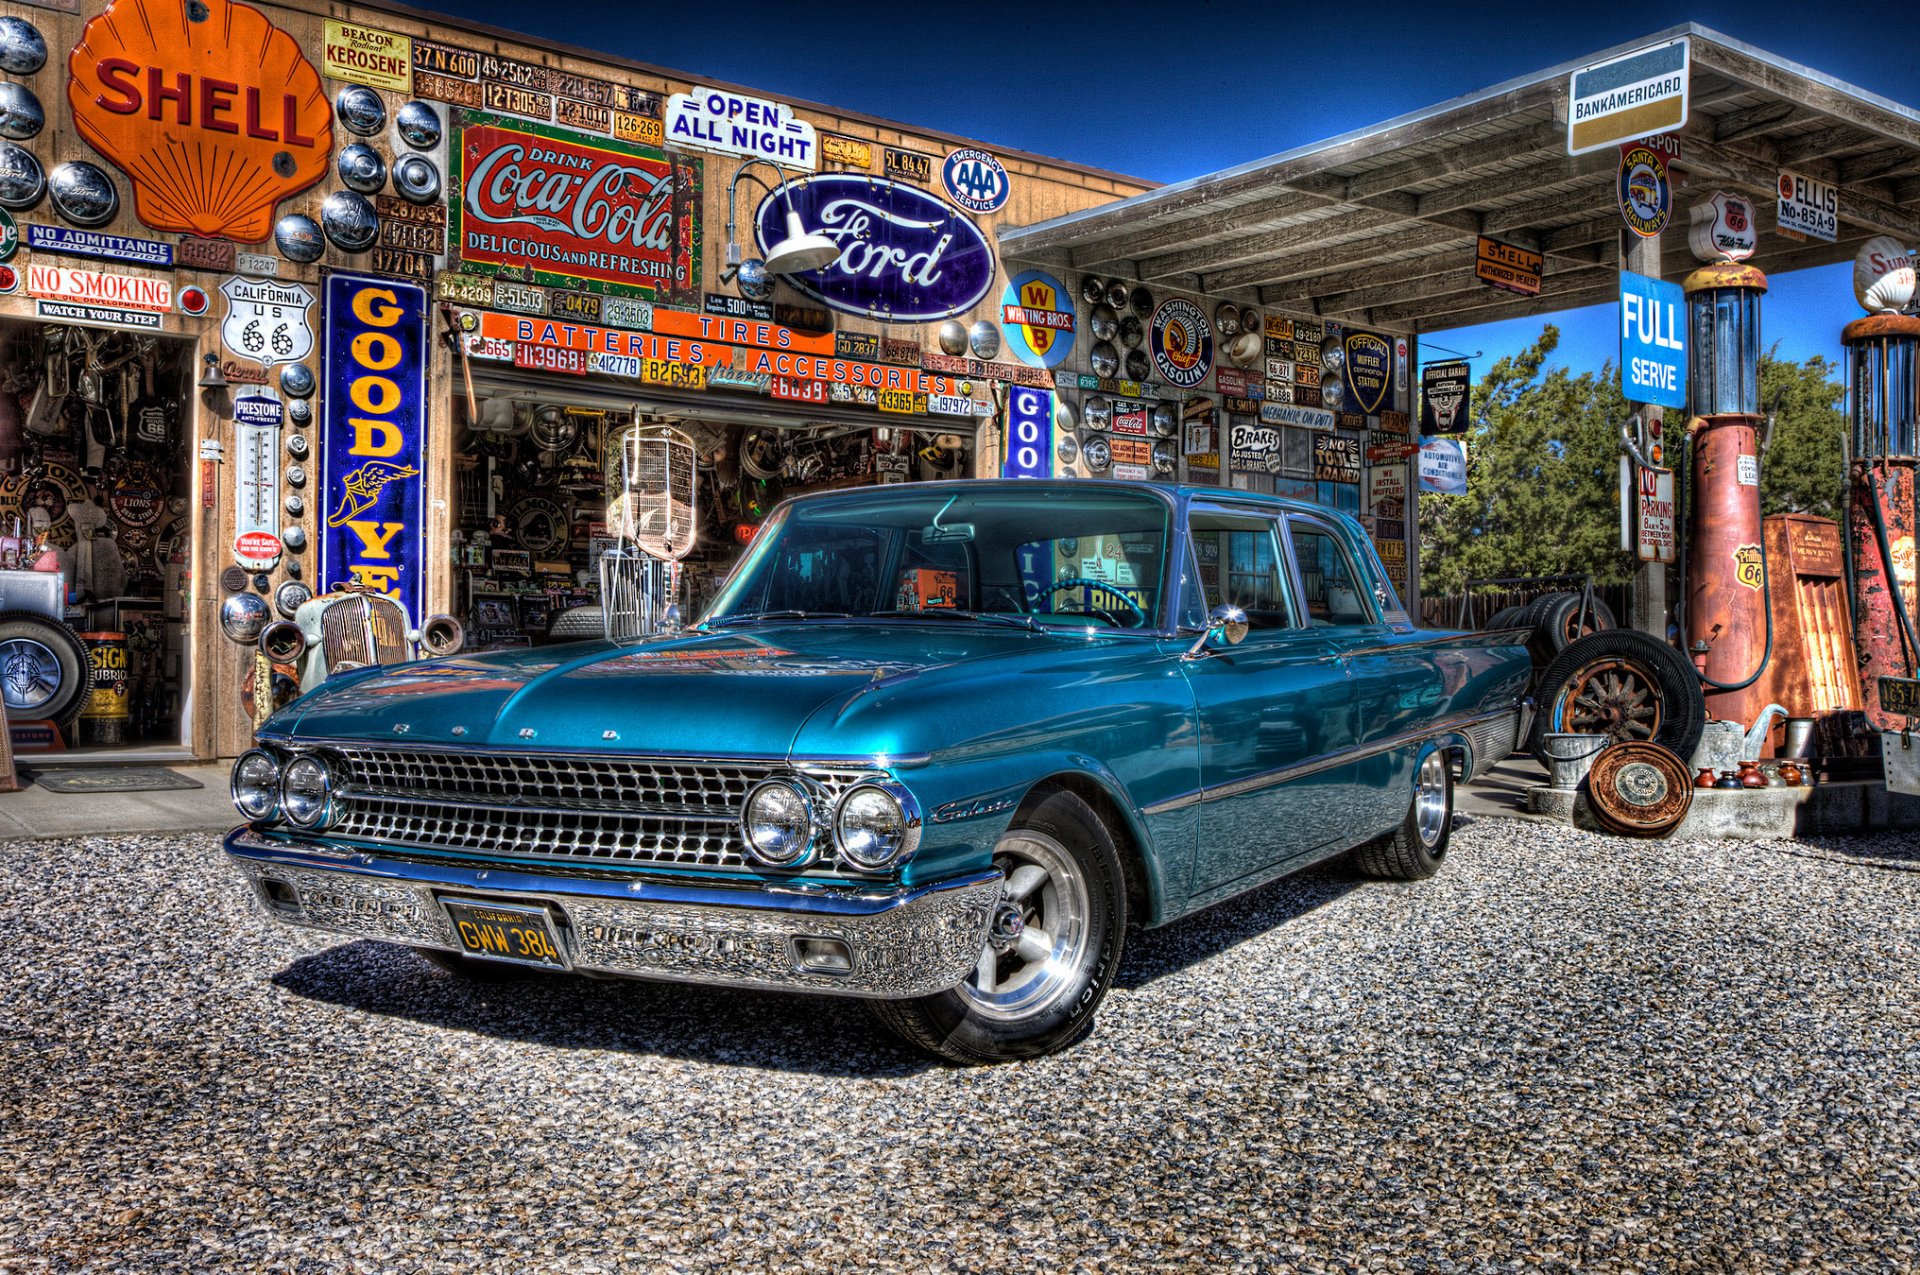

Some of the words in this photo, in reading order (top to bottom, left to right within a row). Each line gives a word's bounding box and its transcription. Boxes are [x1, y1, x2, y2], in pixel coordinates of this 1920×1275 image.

[341, 27, 393, 48] BEACON
[327, 44, 408, 77] KEROSENE
[414, 45, 432, 65] 37
[435, 50, 446, 70] N
[449, 55, 475, 76] 600
[96, 57, 315, 148] SHELL
[1576, 76, 1681, 119] BANKAMERICARD
[707, 94, 779, 128] OPEN
[617, 115, 660, 137] 126-269
[672, 114, 722, 143] ALL
[732, 125, 811, 160] NIGHT
[529, 147, 594, 171] DRINK
[902, 155, 915, 173] 84
[917, 157, 930, 175] 47
[952, 151, 1003, 174] EMERGENCY
[1626, 151, 1654, 171] SANTA
[1654, 162, 1665, 180] FE
[956, 162, 996, 199] AAA
[72, 186, 101, 197] Ford
[466, 144, 674, 252] Coca-Cola
[953, 190, 996, 211] SERVICE
[1796, 177, 1836, 214] ELLIS
[1623, 199, 1667, 232] TRAILWAYS
[1730, 214, 1744, 229] 66
[33, 226, 57, 240] NO
[63, 230, 168, 257] ADMITTANCE
[38, 241, 86, 252] APPLY
[90, 246, 106, 255] AT
[112, 250, 164, 262] OFFICE
[808, 199, 953, 287] Ford
[248, 259, 275, 272] 12247
[468, 231, 561, 262] DELICIOUS
[561, 252, 587, 266] AND
[588, 253, 686, 281] REFRESHING
[1488, 246, 1533, 268] SHELL
[30, 266, 61, 292] NO
[69, 271, 169, 305] SMOKING
[1481, 264, 1514, 281] AUTHORIZED
[1516, 273, 1537, 287] DEALER
[84, 297, 146, 309] DEVELOPMENT
[234, 285, 303, 305] CALIFORNIA
[566, 296, 598, 314] 0479
[1028, 286, 1049, 306] W
[43, 304, 86, 318] WATCH
[89, 308, 122, 321] YOUR
[124, 312, 157, 325] STEP
[706, 303, 726, 312] Requires
[727, 299, 746, 314] 500
[1007, 306, 1045, 325] WHITING
[1046, 311, 1071, 328] BROS.
[1154, 302, 1210, 338] WASHINGTON
[1623, 292, 1683, 350] FULL
[243, 320, 294, 355] 66
[518, 320, 704, 363] BATTERIES
[699, 317, 791, 346] TIRES
[1032, 329, 1048, 349] B
[523, 345, 578, 370] 113968
[854, 341, 875, 355] 2837
[1351, 337, 1386, 357] OFFICIAL
[600, 354, 637, 375] 412778
[1156, 352, 1208, 384] GASOLINE
[1172, 351, 1192, 367] Chief
[1357, 354, 1379, 367] MUFFLER
[709, 359, 771, 394] Liberty
[756, 352, 948, 394] ACCESSORIES
[1218, 376, 1245, 387] GASOLINE
[1357, 376, 1379, 389] STATION
[1426, 369, 1447, 380] OFFICIAL
[1448, 366, 1468, 377] GARAGE
[1631, 358, 1677, 392] SERVE
[237, 401, 281, 417] PRESTONE
[881, 390, 911, 411] 43365
[939, 395, 970, 414] 197972
[1237, 400, 1257, 411] SMITH
[241, 415, 277, 423] ANTI-FREEZE
[1263, 404, 1298, 423] MECHANIC
[1302, 410, 1315, 423] ON
[1316, 413, 1334, 428] DUTY
[148, 424, 165, 434] 66
[1234, 428, 1278, 450] BRAKES
[1120, 445, 1148, 454] ADMITTANCE
[1232, 449, 1267, 460] ADJUSTED!
[1329, 439, 1346, 451] NO
[1315, 449, 1360, 468] TOOLS
[1315, 465, 1360, 482] LOANED
[1376, 477, 1400, 486] INSTALL
[1373, 486, 1404, 496] MUFFLERS
[124, 498, 151, 508] LIONS
[1641, 500, 1672, 519] PARKING
[1641, 530, 1661, 538] BETWEEN
[1644, 518, 1649, 529] 8
[1660, 519, 1664, 531] 5
[1105, 543, 1121, 559] 24
[1648, 539, 1662, 547] SCHOOL
[1745, 565, 1761, 584] 66
[933, 800, 1016, 823] Galaxie
[474, 910, 523, 923] CALIFORNIA
[459, 921, 508, 954] GWW
[511, 929, 557, 959] 384
